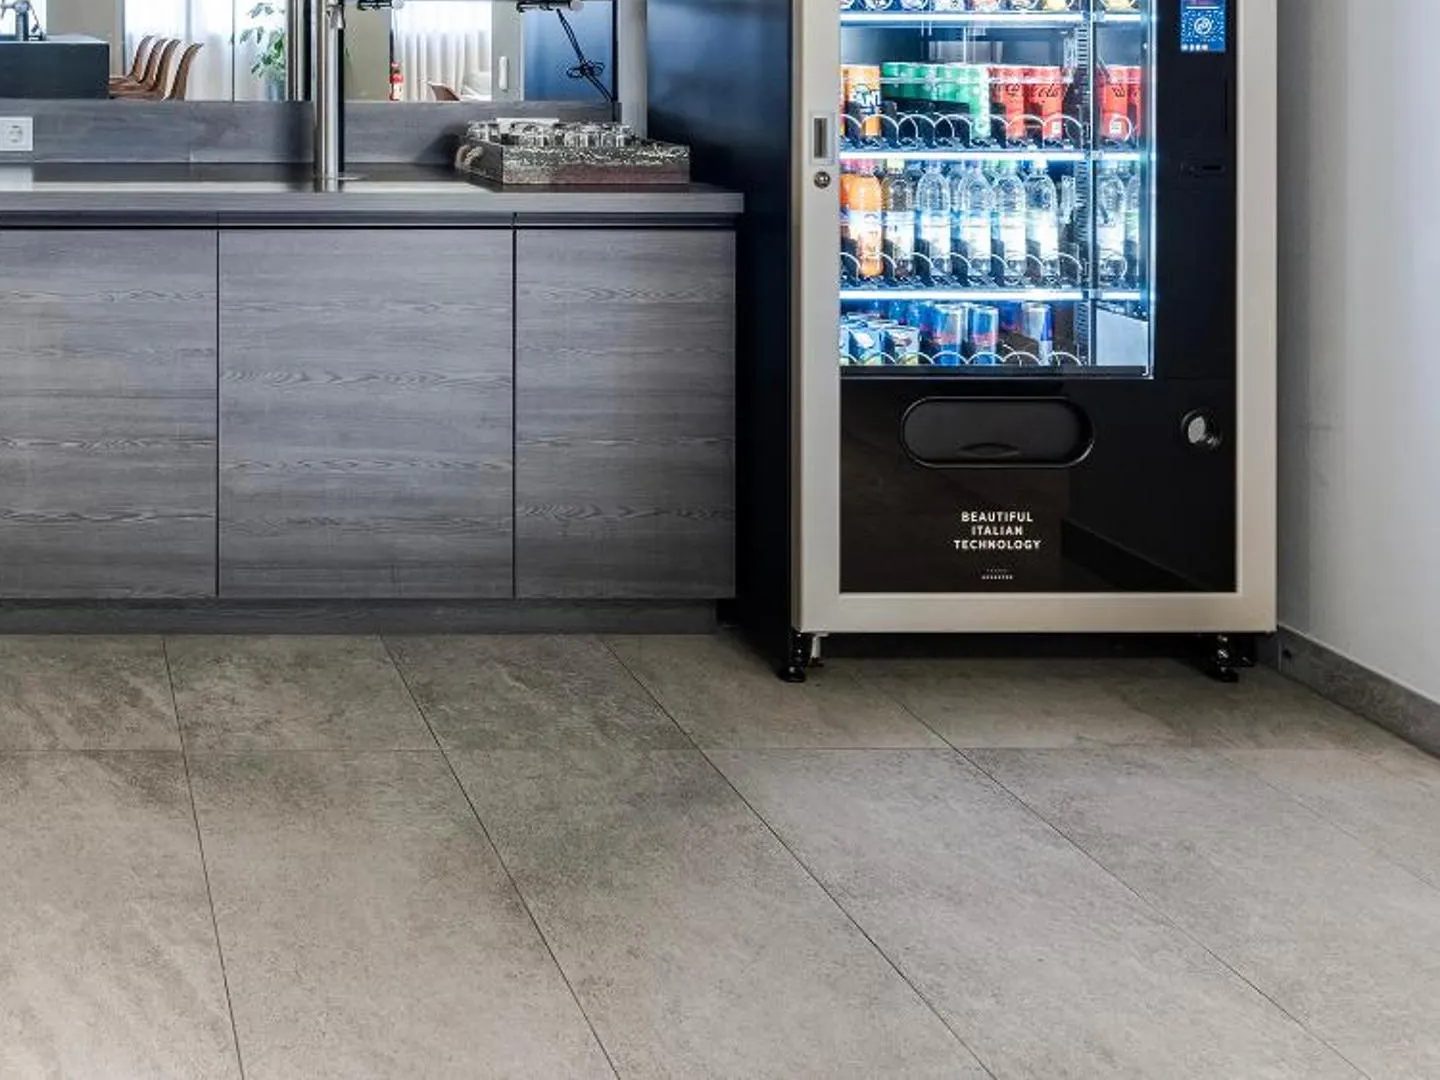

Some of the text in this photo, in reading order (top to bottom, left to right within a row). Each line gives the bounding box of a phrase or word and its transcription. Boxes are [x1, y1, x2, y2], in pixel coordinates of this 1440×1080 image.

[961, 511, 1034, 522] BEAUTIFUL
[971, 525, 1024, 536] ITALIAN
[953, 539, 1041, 550] TECHNOLOGY
